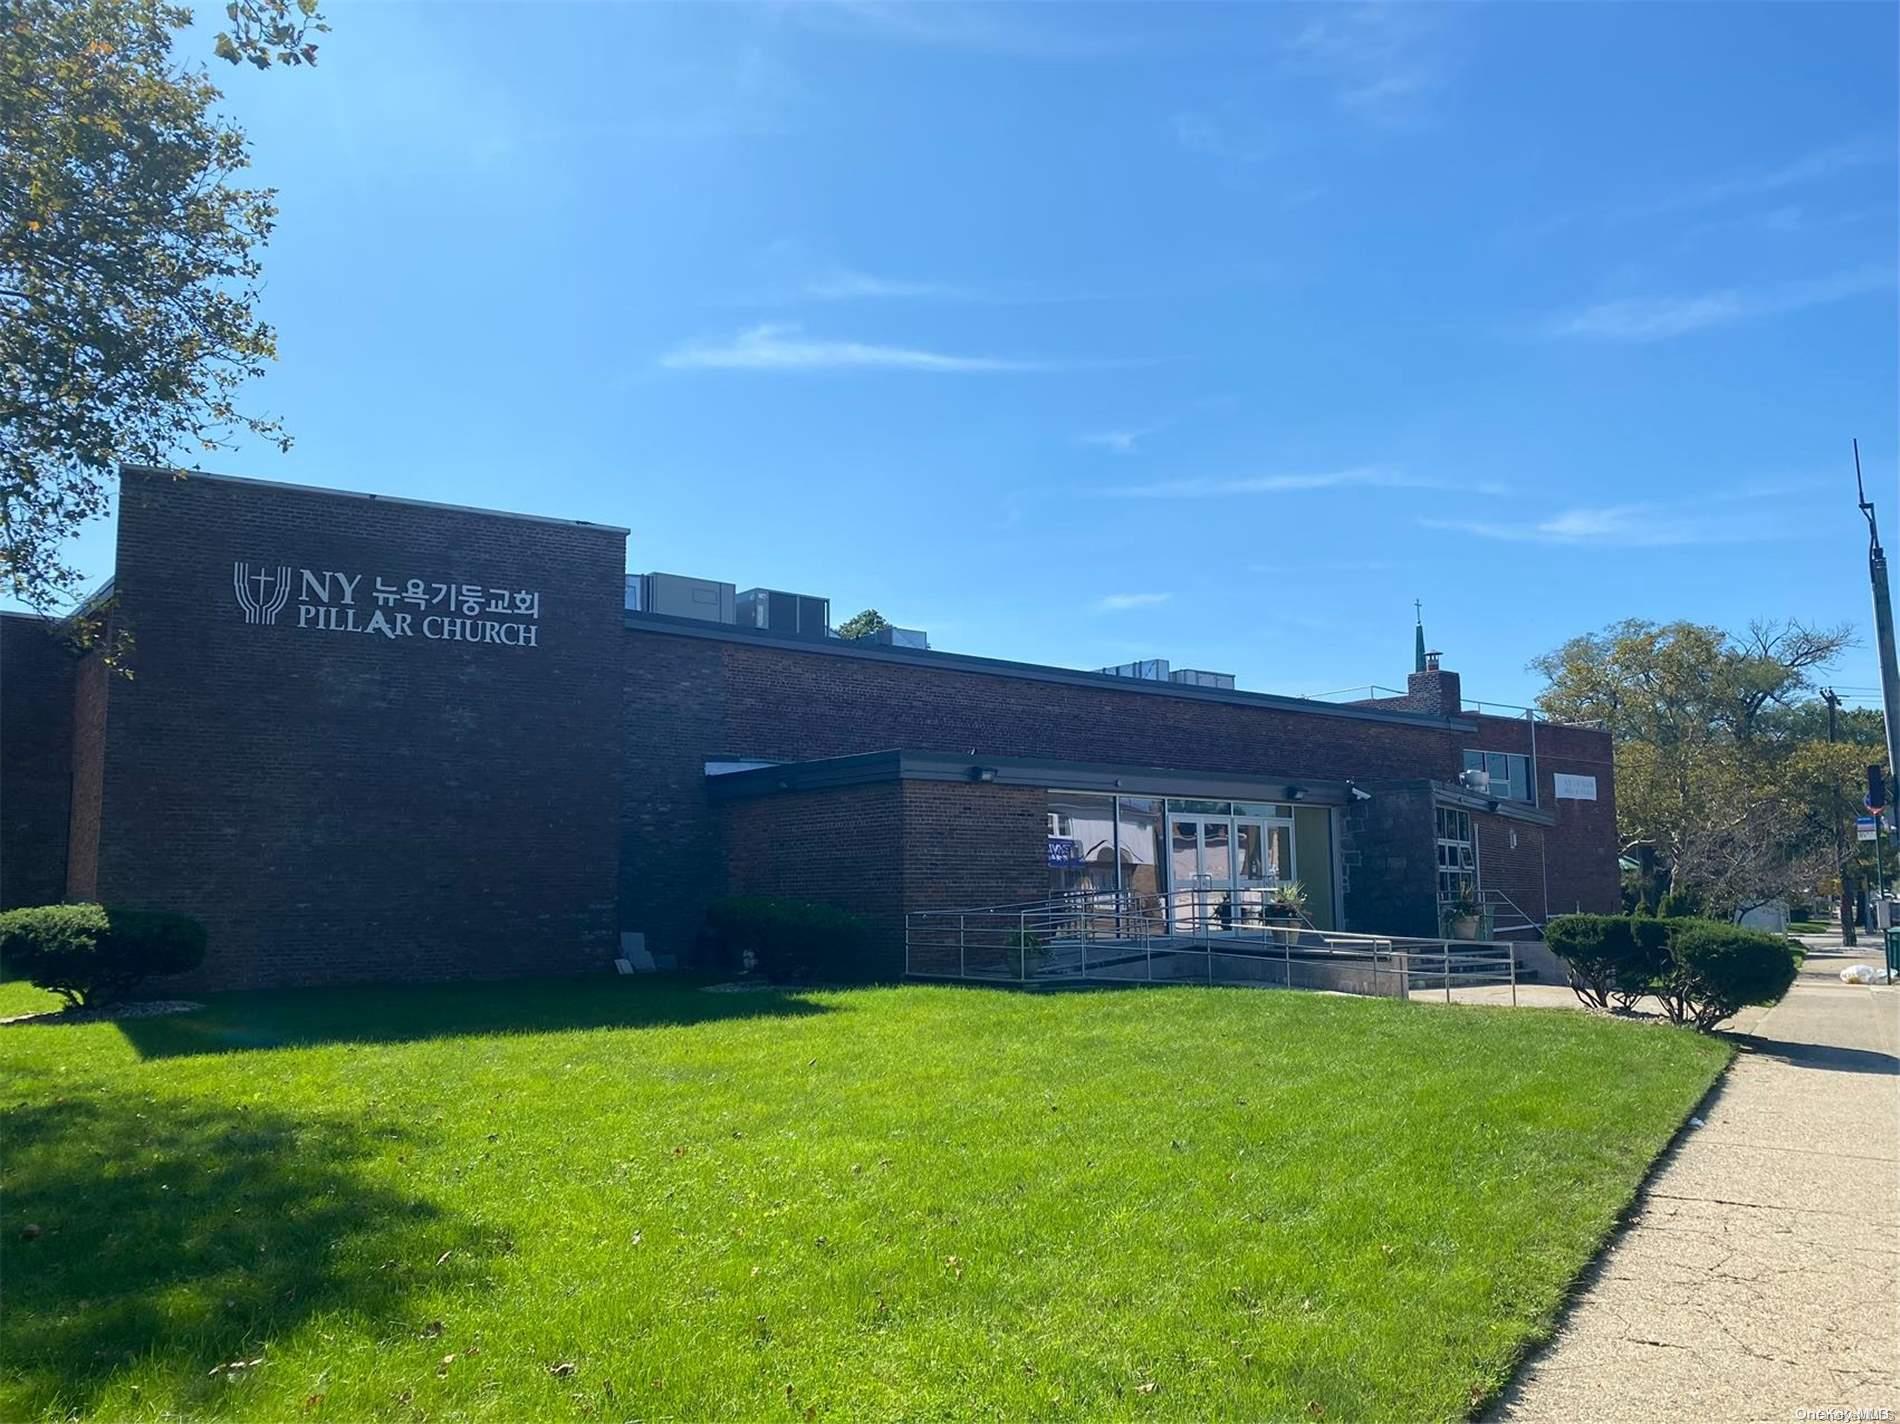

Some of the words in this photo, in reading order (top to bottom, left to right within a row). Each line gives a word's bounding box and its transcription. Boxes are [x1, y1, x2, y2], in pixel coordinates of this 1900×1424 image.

[298, 569, 362, 604] NY
[372, 576, 539, 619] 뉴욕기둥교회
[297, 605, 414, 639] PILLAR
[422, 616, 538, 647] CHURCH
